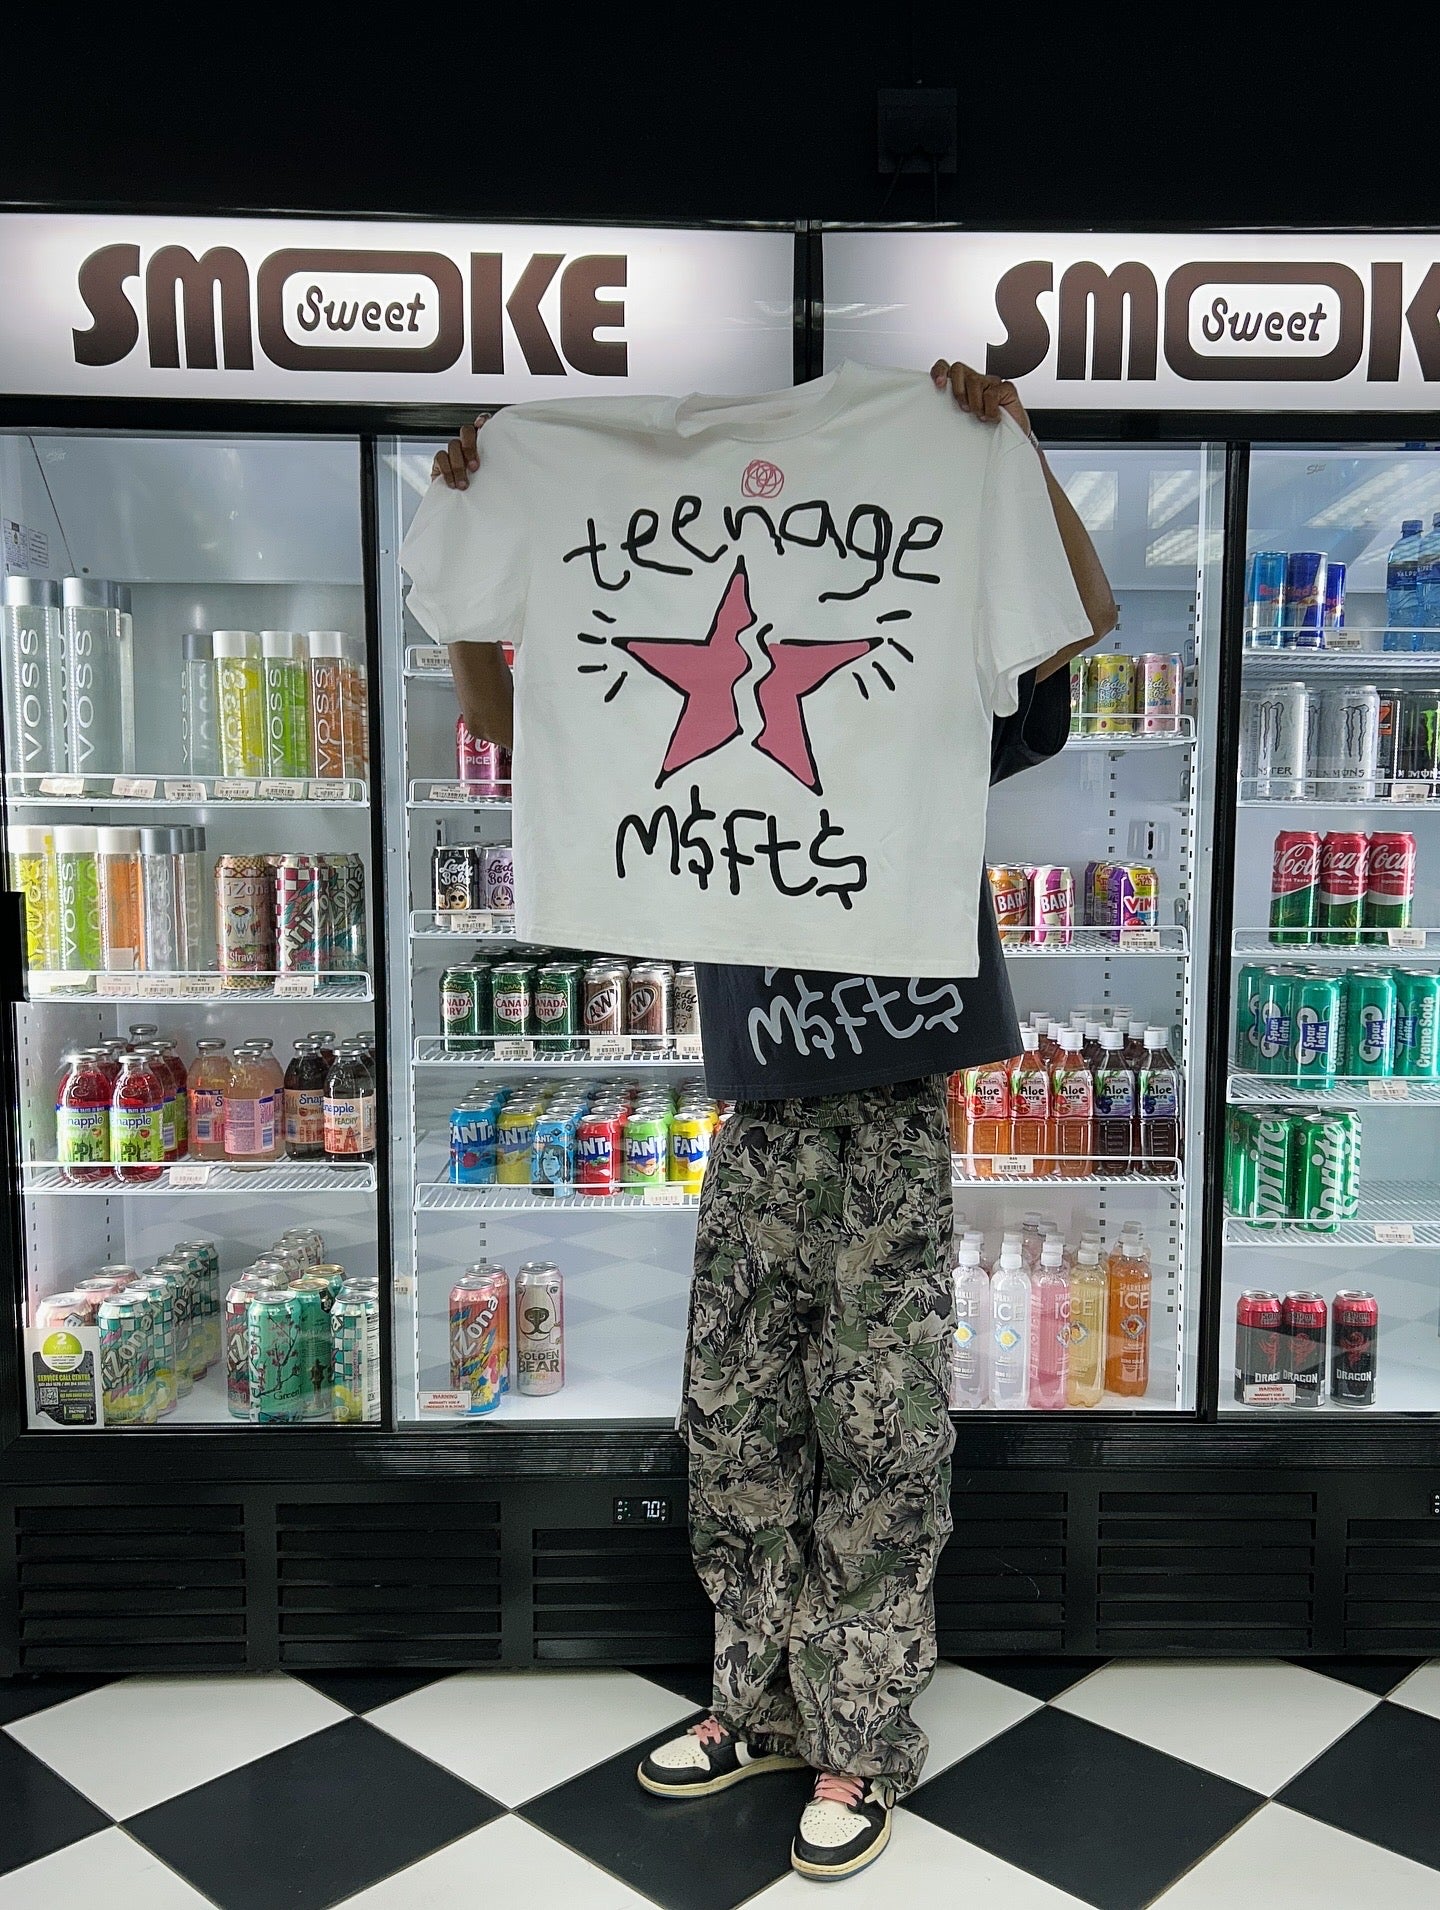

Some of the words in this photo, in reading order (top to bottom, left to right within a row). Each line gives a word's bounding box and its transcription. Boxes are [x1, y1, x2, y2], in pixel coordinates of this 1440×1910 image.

[72, 243, 628, 377] SMOKE
[296, 285, 426, 333] Sweet
[1202, 297, 1328, 343] Sweet
[563, 494, 944, 603] teenage
[20, 629, 43, 762] VOSS
[75, 630, 95, 762] VOSS
[269, 668, 285, 765] VOSS
[316, 668, 332, 770] VOSS
[465, 756, 497, 765] PICED
[439, 859, 474, 877] Lady
[440, 871, 471, 885] Boba
[62, 862, 77, 956] VOSS
[447, 998, 473, 1008] NADA
[539, 1007, 557, 1017] DRY
[1279, 1019, 1290, 1042] letta
[1315, 1025, 1327, 1048] letta
[1416, 1028, 1433, 1068] Creme
[975, 1085, 1000, 1096] Aloe
[1020, 1085, 1045, 1096] Aloe
[1060, 1085, 1085, 1095] Aloe
[1104, 1085, 1130, 1095] Aloe
[1148, 1085, 1173, 1095] Aloe
[68, 1114, 104, 1129] napple
[117, 1114, 152, 1129] napple
[1249, 1120, 1290, 1229] Sprite
[1310, 1122, 1347, 1229] Sprite
[956, 1298, 980, 1318] CE
[1070, 1297, 1094, 1316] CE
[1120, 1291, 1150, 1310] ICE
[993, 1301, 1024, 1321] ICE
[56, 1332, 67, 1345] 2
[518, 1350, 560, 1361] GOLDEN
[518, 1360, 561, 1373] BEAR
[1336, 1368, 1372, 1381] DRAGON
[1283, 1370, 1319, 1384] DRAGON
[273, 1390, 299, 1400] Green
